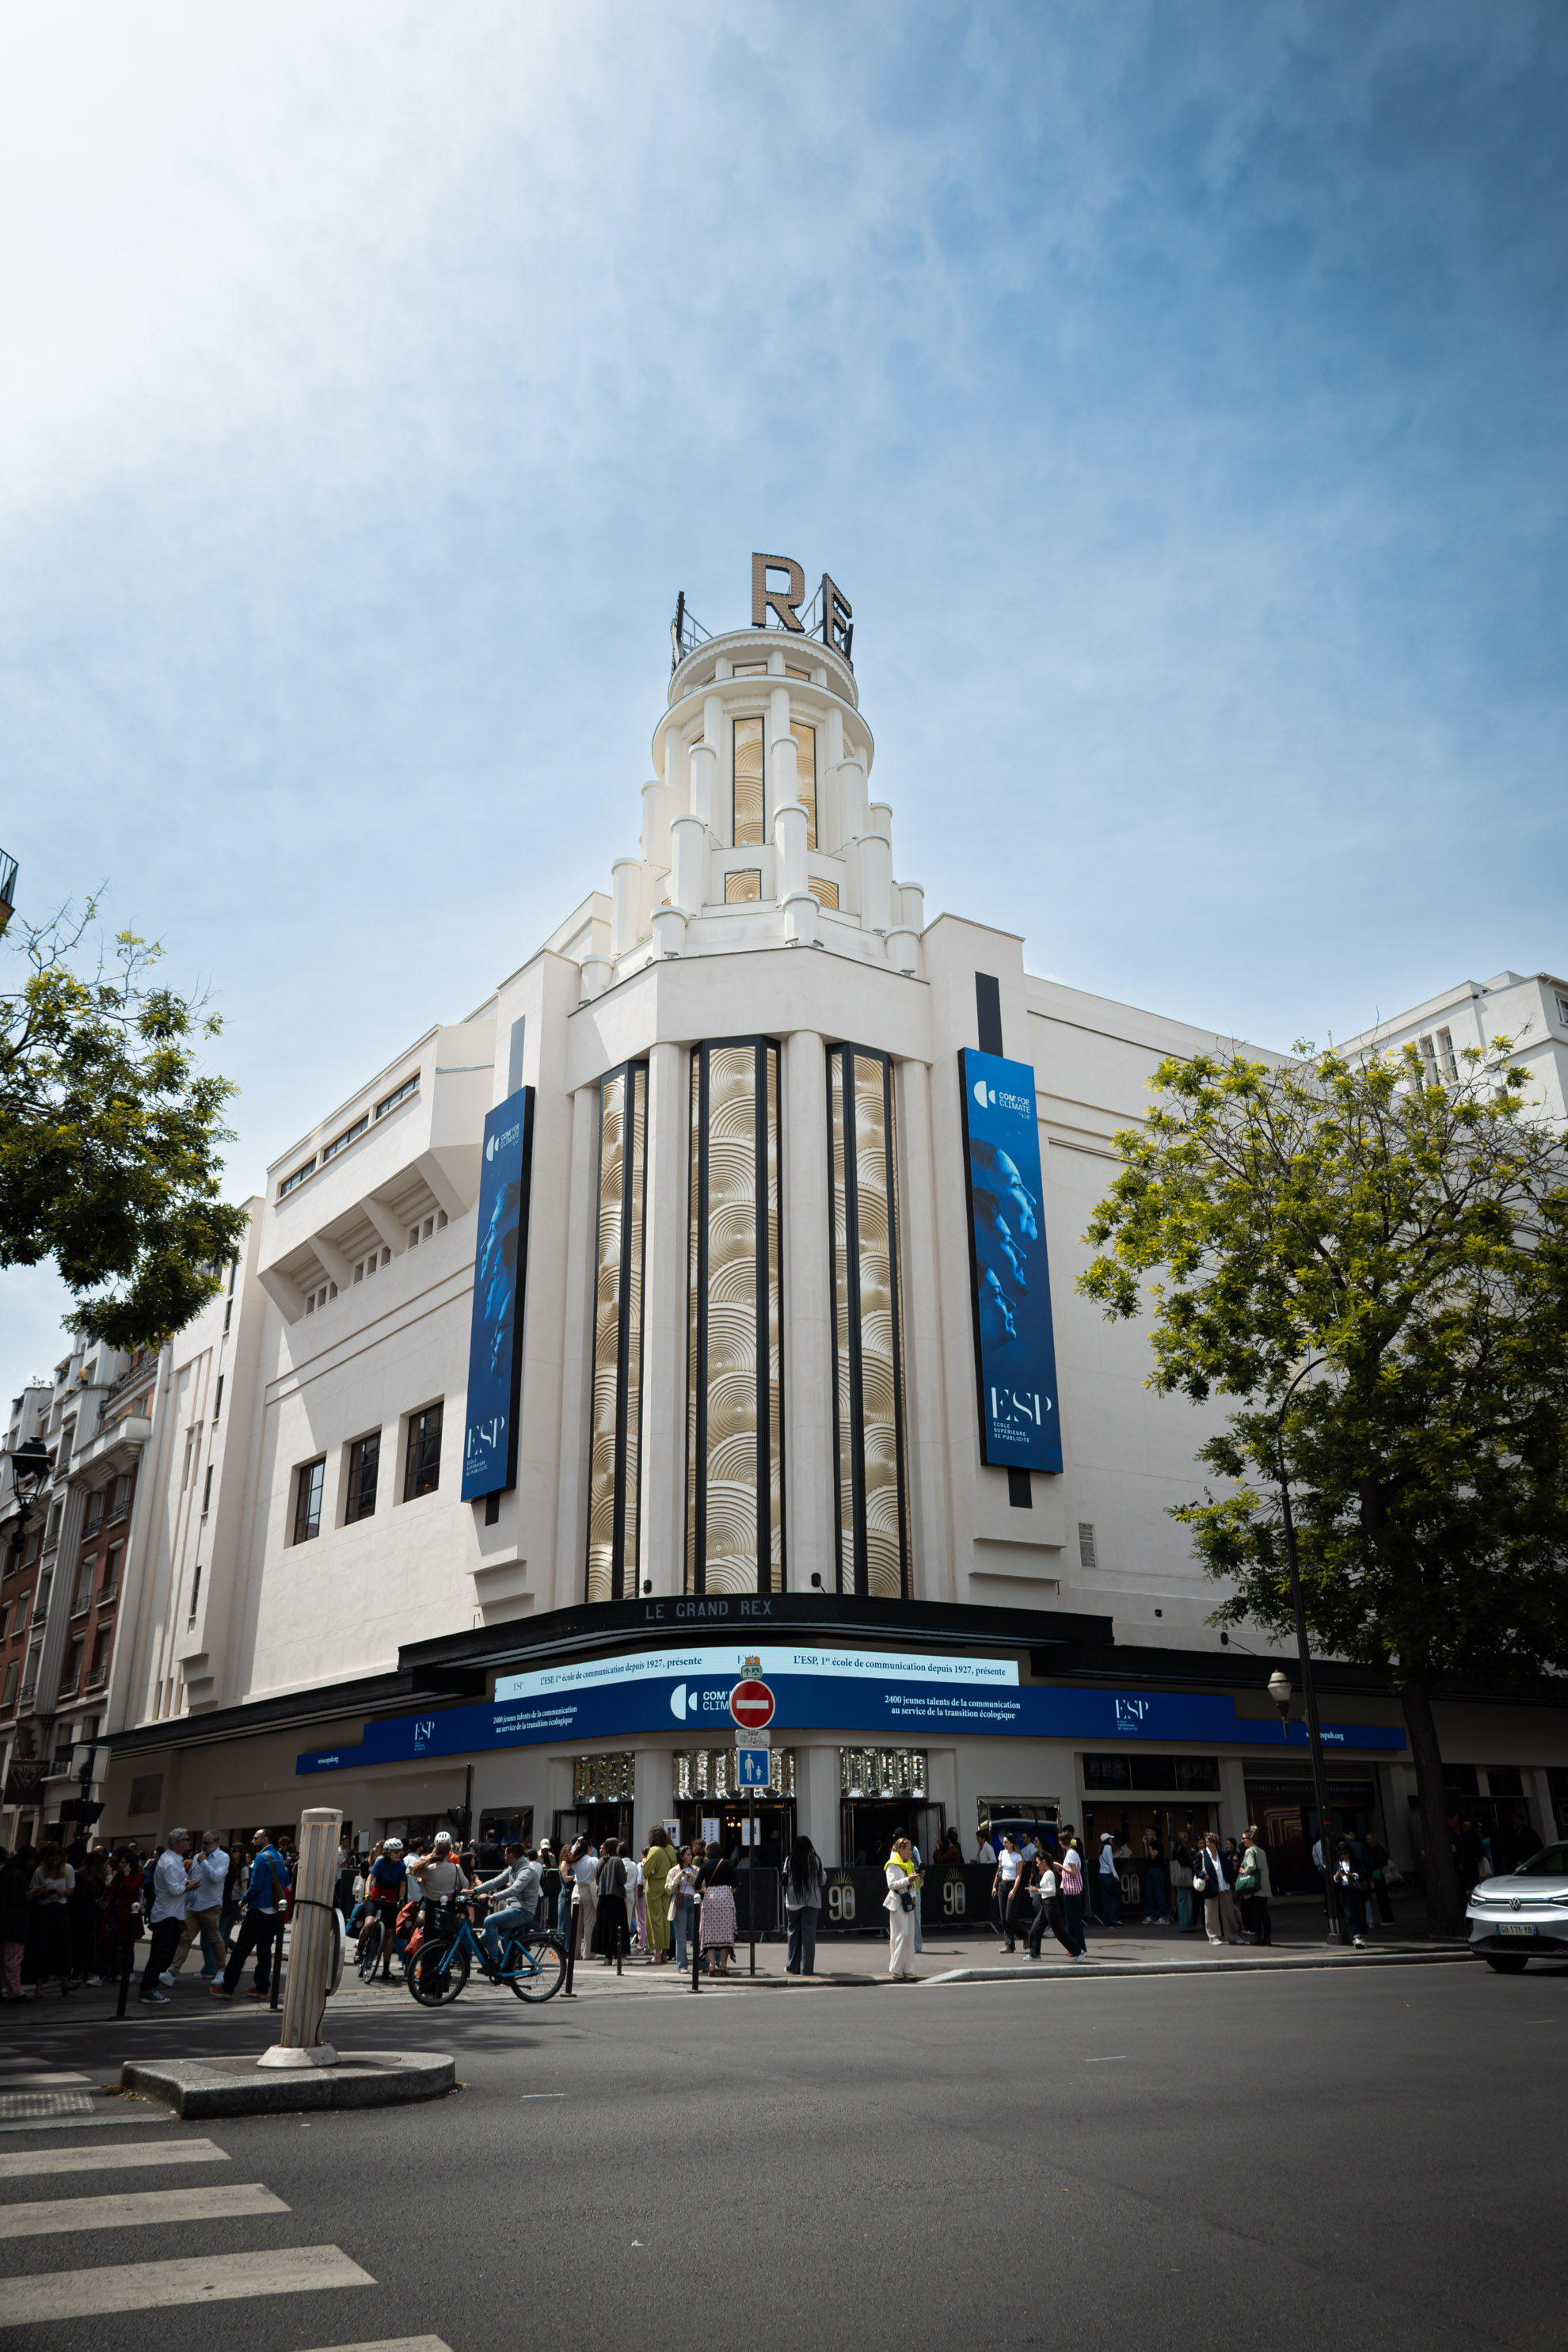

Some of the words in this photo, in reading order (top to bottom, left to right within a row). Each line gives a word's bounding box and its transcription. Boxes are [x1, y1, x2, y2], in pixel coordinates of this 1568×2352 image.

[752, 552, 854, 673] RE
[999, 1091, 1017, 1102] COM'
[1017, 1096, 1030, 1106] FOR
[999, 1099, 1031, 1114] CLIMATE
[500, 1130, 520, 1148] CLIMATE
[991, 1387, 1052, 1425] ESP
[466, 1416, 505, 1458] ESP
[1003, 1434, 1030, 1443] PUBLICITÉ
[645, 1604, 665, 1619] LE
[676, 1600, 729, 1617] GRAND
[740, 1600, 772, 1616] REX
[562, 1672, 575, 1682] école
[576, 1671, 582, 1679] de
[582, 1665, 624, 1678] communication
[625, 1661, 645, 1673] depuis
[646, 1659, 665, 1669] 1927,
[667, 1657, 702, 1669] présente
[832, 1657, 853, 1667] école
[854, 1658, 864, 1667] de
[866, 1661, 926, 1671] communication
[928, 1663, 953, 1674] depuis
[955, 1665, 974, 1675] 1927,
[976, 1667, 1006, 1676] présente
[702, 1701, 729, 1711] CLIM
[885, 1695, 902, 1703] 2400
[903, 1695, 926, 1706] jeunes
[926, 1697, 950, 1706] talents
[951, 1697, 959, 1707] de
[960, 1698, 967, 1707] la
[968, 1700, 1021, 1709] communication
[1115, 1699, 1149, 1720] ESP
[493, 1715, 503, 1724] 2400
[503, 1715, 516, 1724] jeunes
[517, 1712, 531, 1722] talents
[531, 1710, 537, 1718] de
[542, 1705, 577, 1717] communication
[901, 1707, 926, 1715] service
[927, 1707, 936, 1716] de
[936, 1707, 944, 1716] la
[945, 1708, 978, 1718] transition
[980, 1709, 1016, 1720] écologique
[415, 1721, 435, 1741] ESP
[501, 1723, 516, 1732] service
[526, 1719, 548, 1729] transition
[548, 1716, 573, 1727] écologique
[943, 1881, 966, 1916] 90
[1121, 1873, 1141, 1905] 90
[828, 1885, 856, 1921] 90
